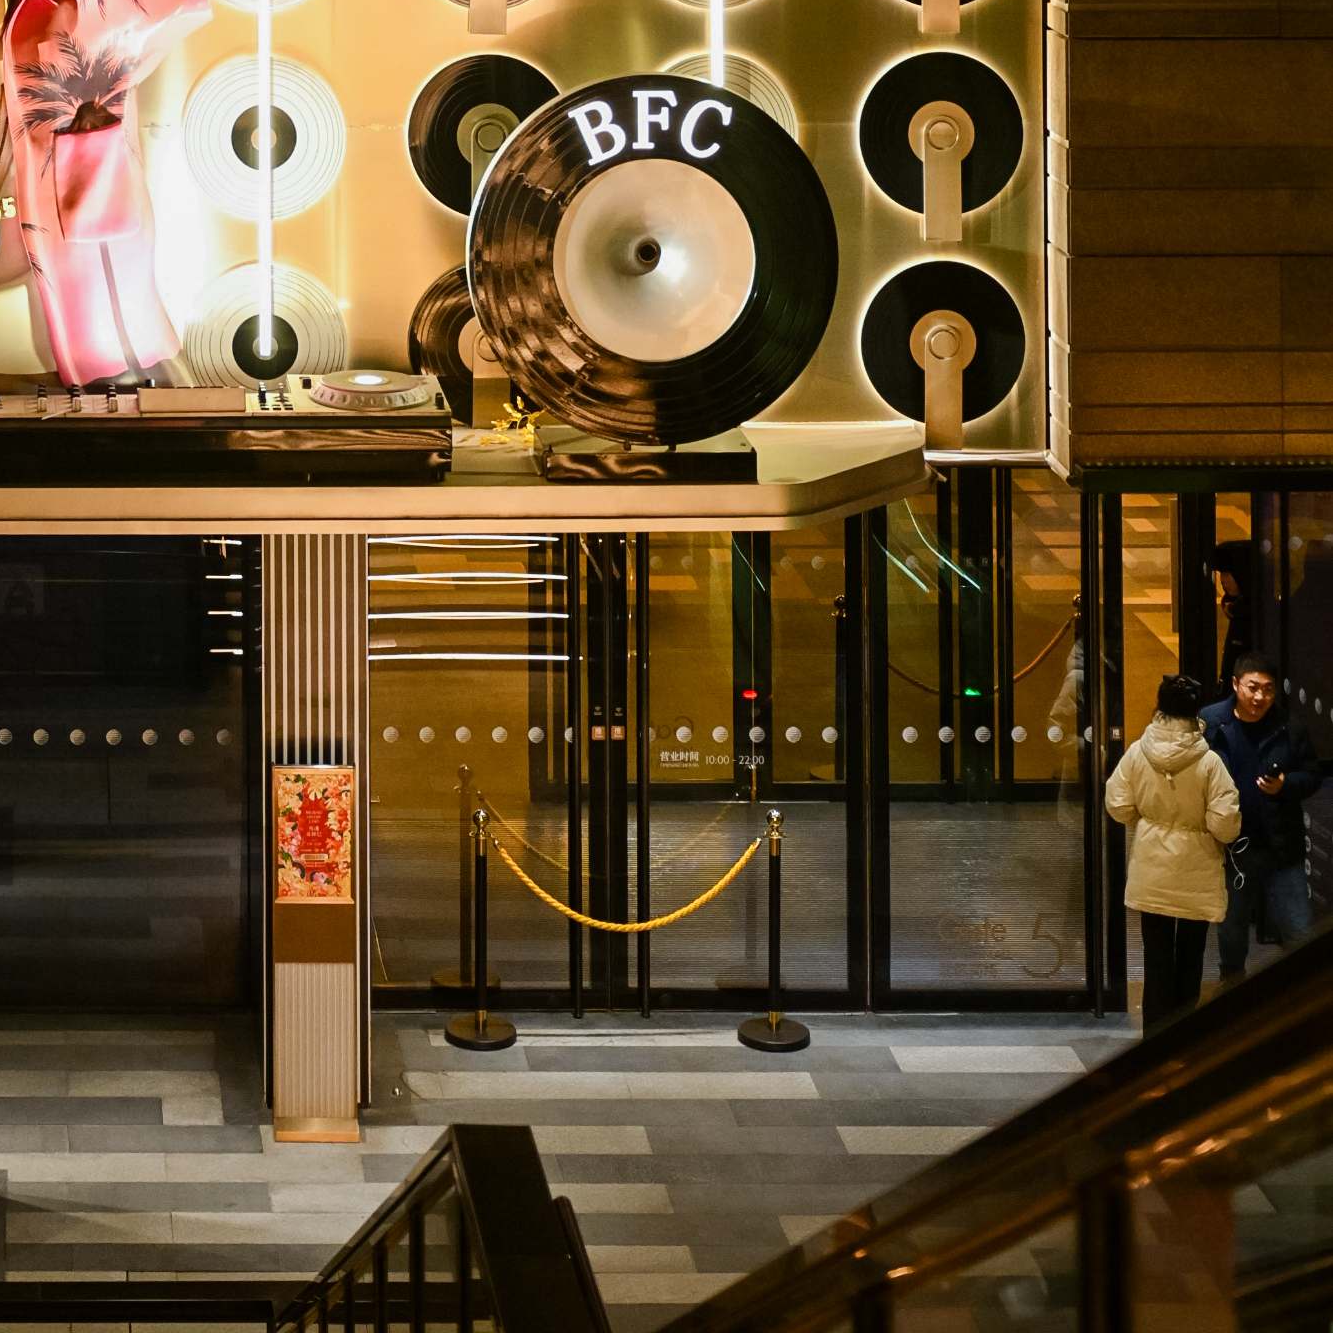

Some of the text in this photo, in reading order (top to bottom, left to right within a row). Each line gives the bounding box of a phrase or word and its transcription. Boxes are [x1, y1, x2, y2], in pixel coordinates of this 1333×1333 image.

[568, 90, 733, 166] BFC
[705, 755, 730, 765] 10:00
[739, 755, 765, 766] 22:00
